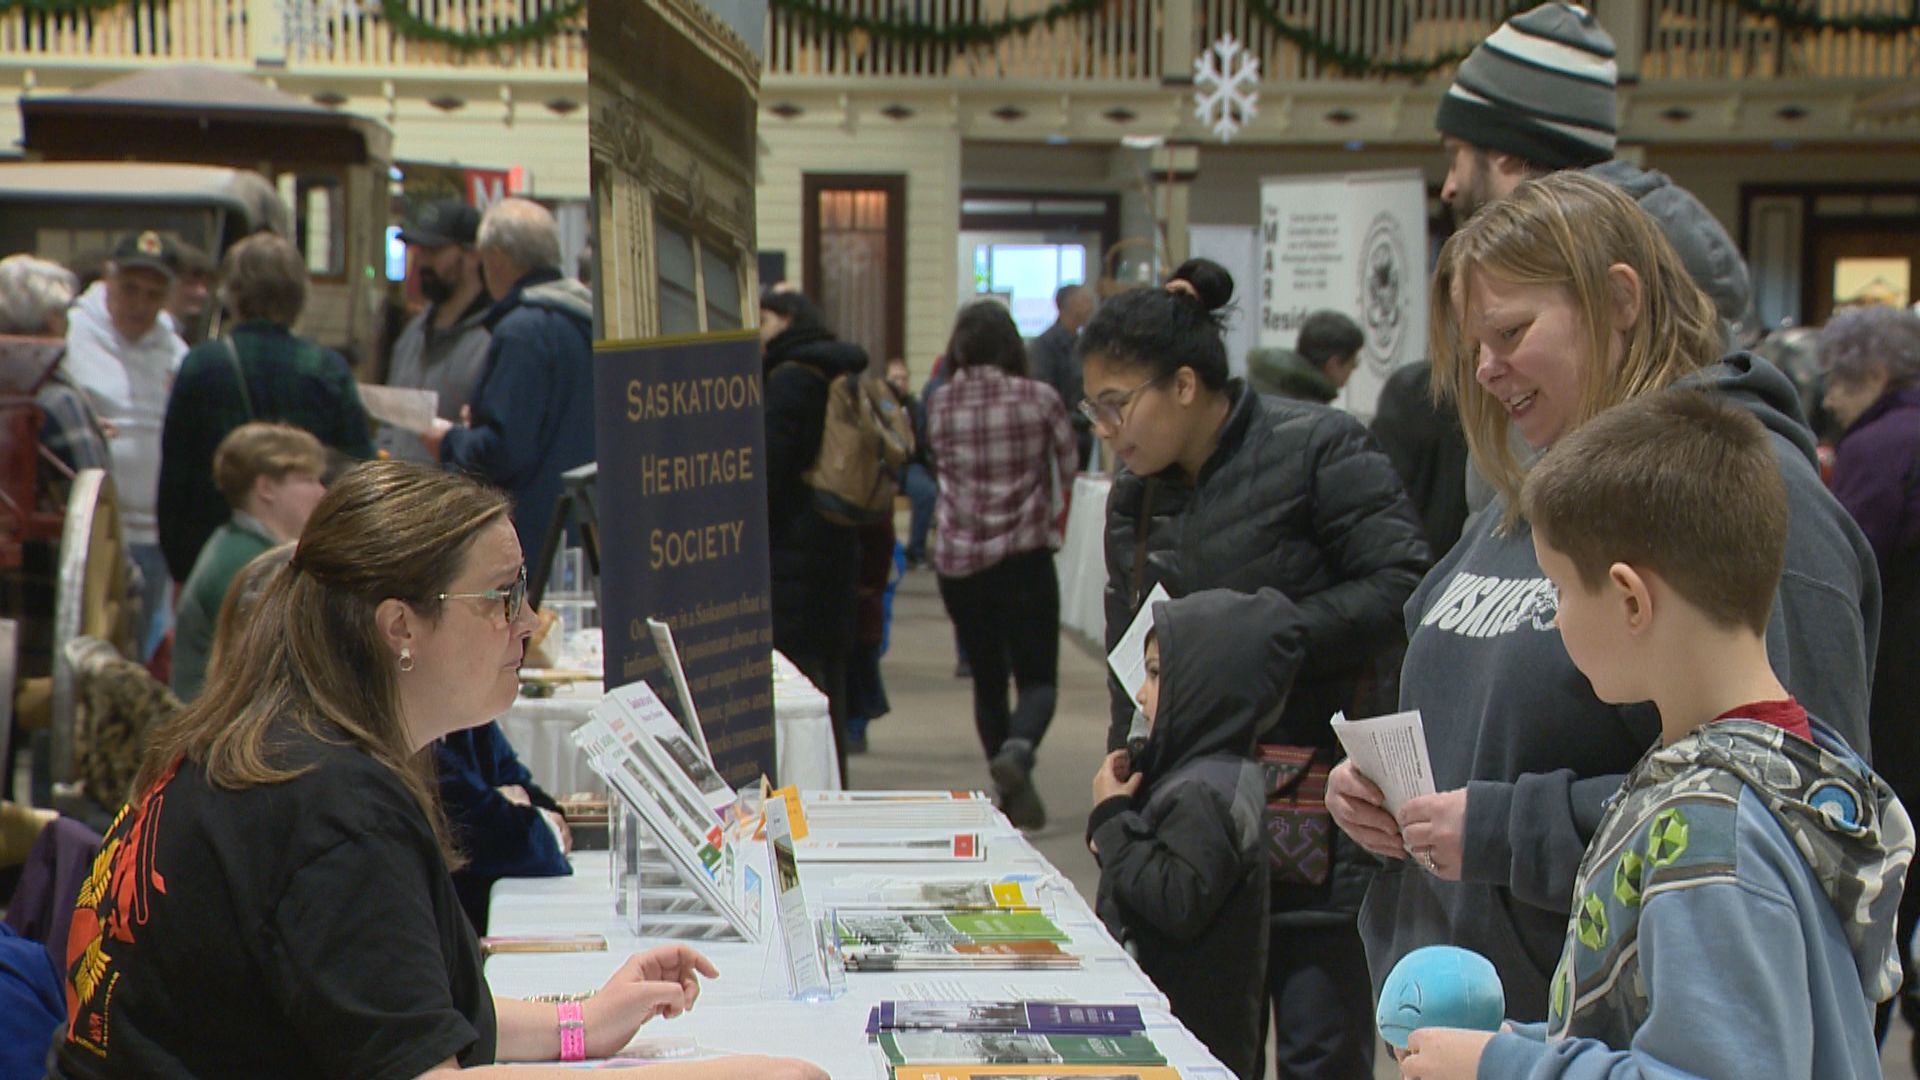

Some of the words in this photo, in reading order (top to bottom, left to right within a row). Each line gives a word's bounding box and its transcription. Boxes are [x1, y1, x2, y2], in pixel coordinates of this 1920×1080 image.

[627, 374, 761, 422] SASKATOON
[641, 447, 753, 496] HERITAGE
[650, 519, 744, 571] SOCIETY
